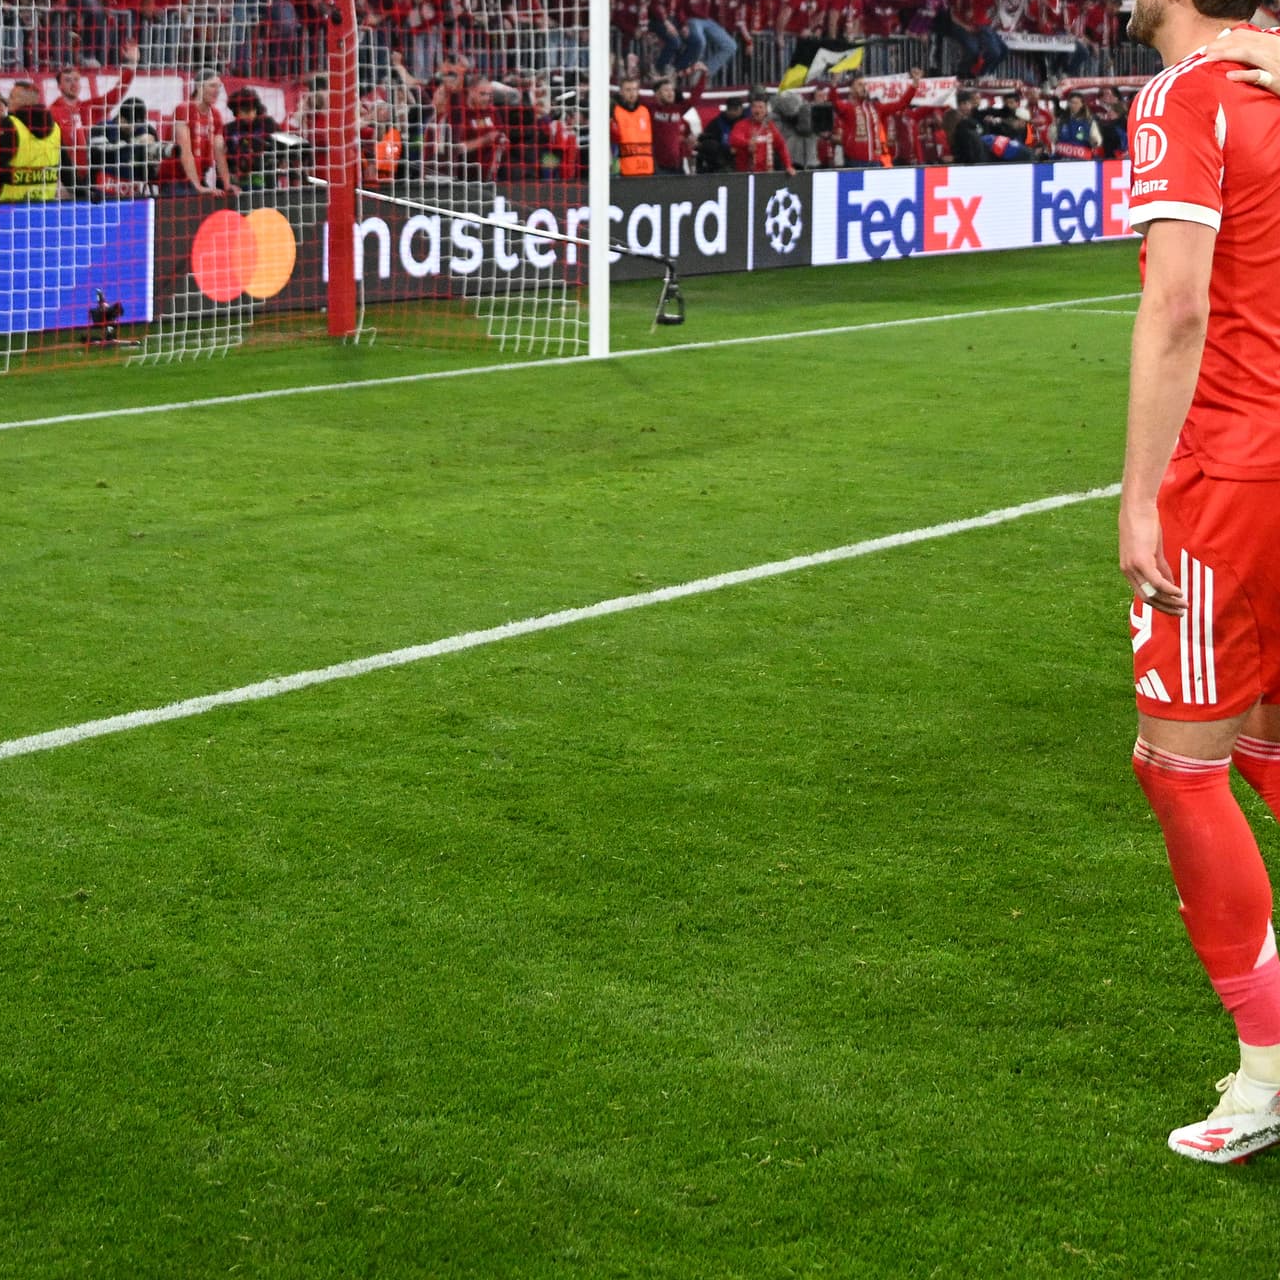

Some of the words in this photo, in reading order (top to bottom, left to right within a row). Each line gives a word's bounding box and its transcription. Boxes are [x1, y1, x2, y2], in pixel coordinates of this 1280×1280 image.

[14, 169, 59, 184] STEWAR
[1131, 179, 1168, 196] llianz
[836, 167, 983, 260] FedEx
[1032, 160, 1132, 244] FedE
